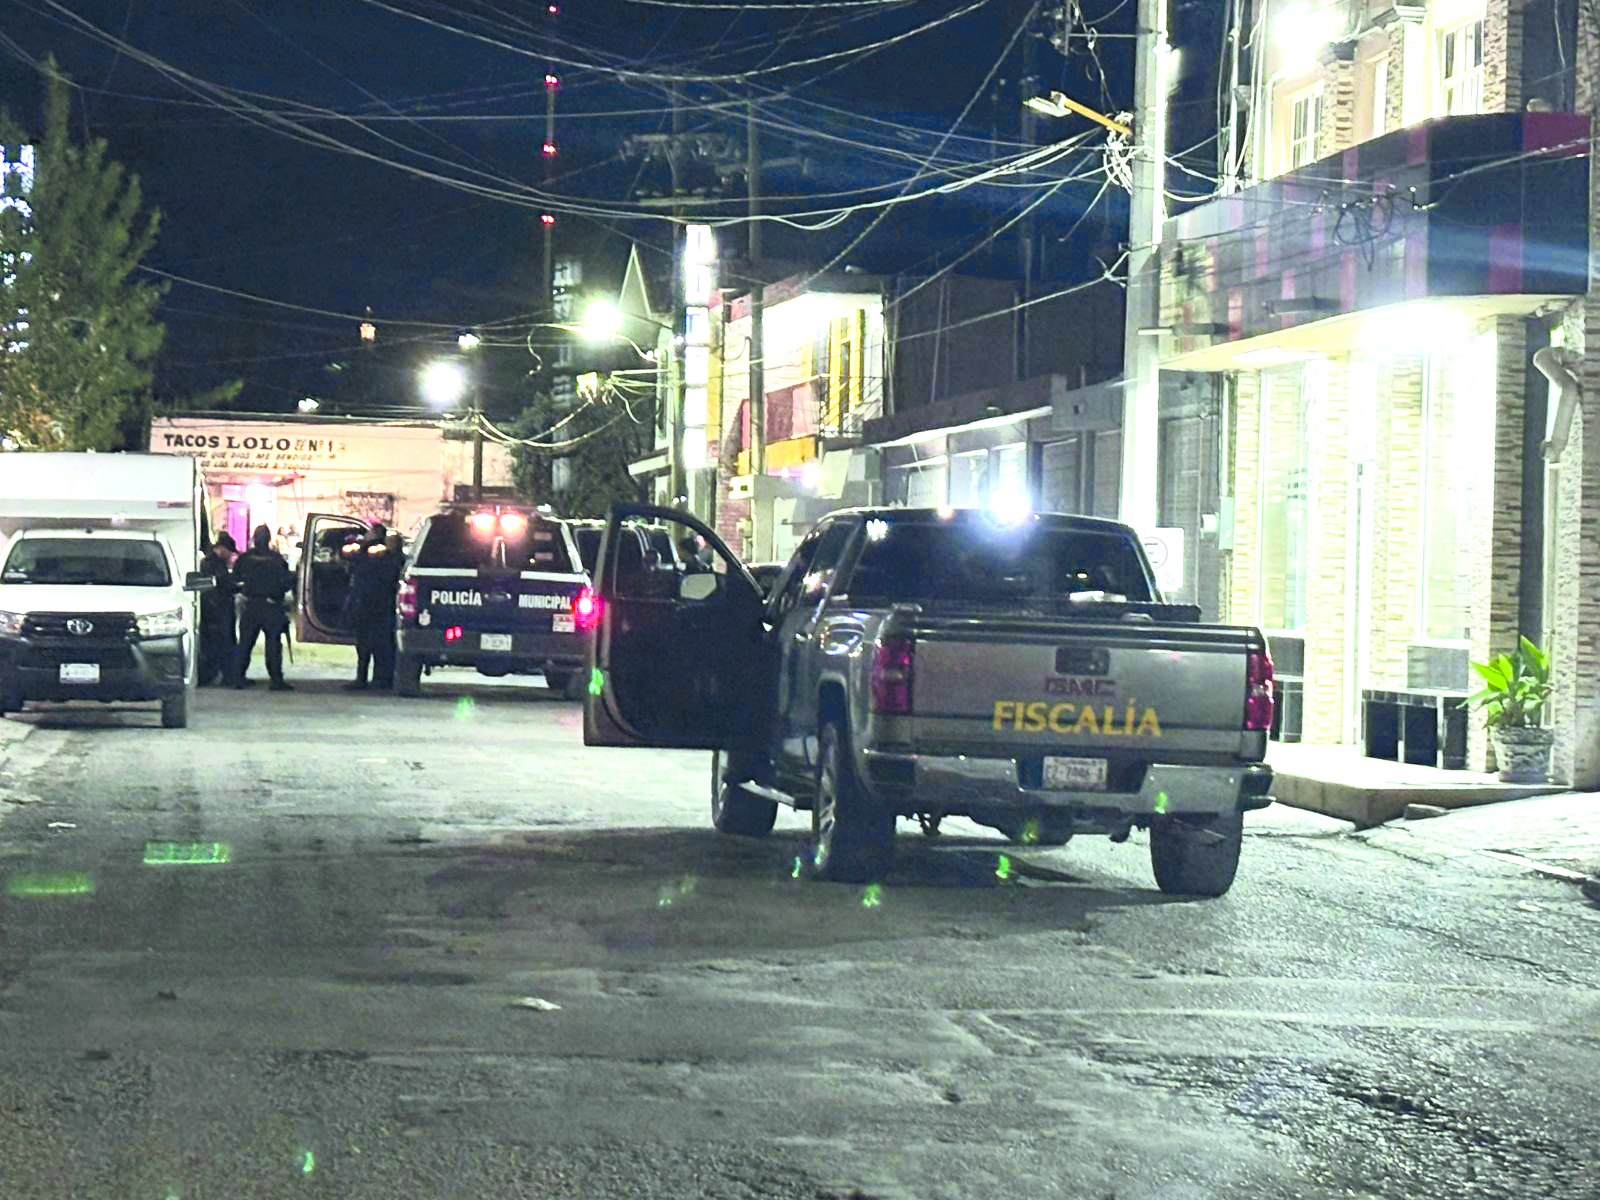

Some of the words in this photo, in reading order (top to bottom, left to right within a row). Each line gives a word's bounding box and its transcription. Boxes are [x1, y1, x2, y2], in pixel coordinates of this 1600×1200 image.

[164, 434, 219, 448] TACOS
[226, 436, 291, 451] LOLO
[431, 589, 482, 606] POLICÍA
[518, 594, 573, 610] MUNICIPAL
[993, 697, 1162, 737] FISCALÍA
